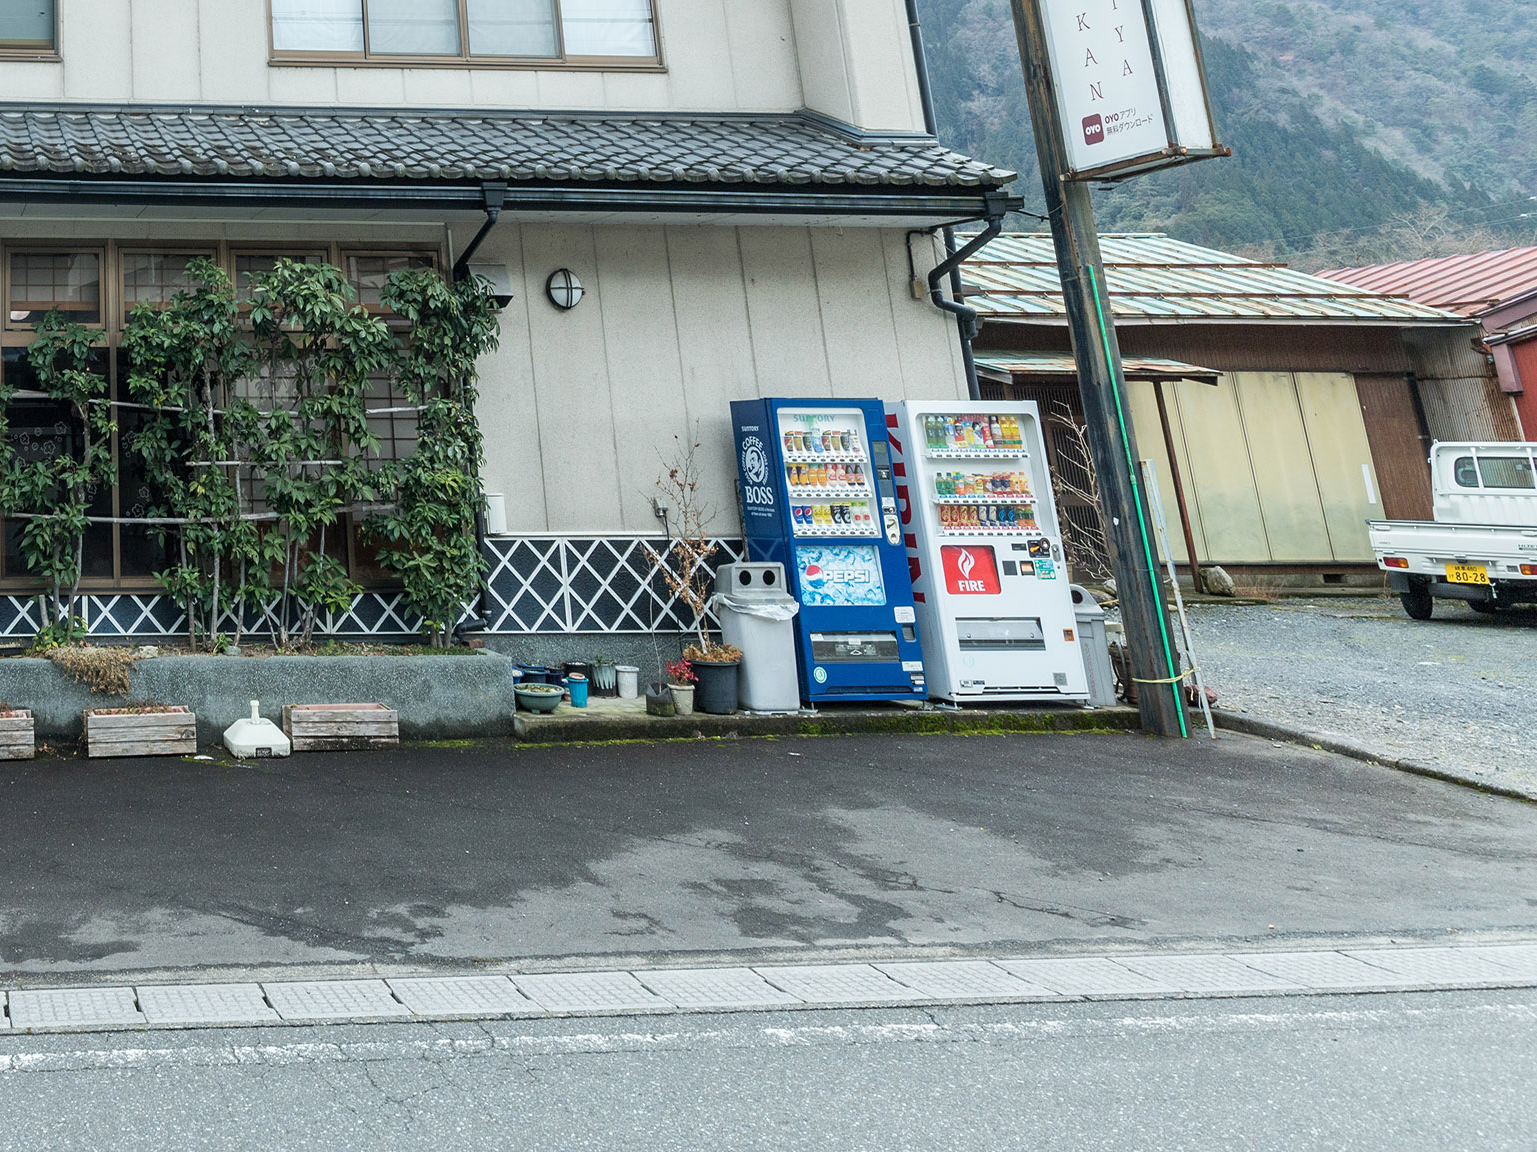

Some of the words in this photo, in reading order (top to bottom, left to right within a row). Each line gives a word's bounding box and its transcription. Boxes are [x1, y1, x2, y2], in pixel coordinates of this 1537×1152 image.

[1085, 123, 1102, 136] OYO
[742, 436, 764, 451] COFFEE
[745, 486, 774, 505] BOSS
[822, 569, 871, 584] PEPSI
[1455, 572, 1486, 583] 80-28
[957, 579, 986, 592] FIRE
